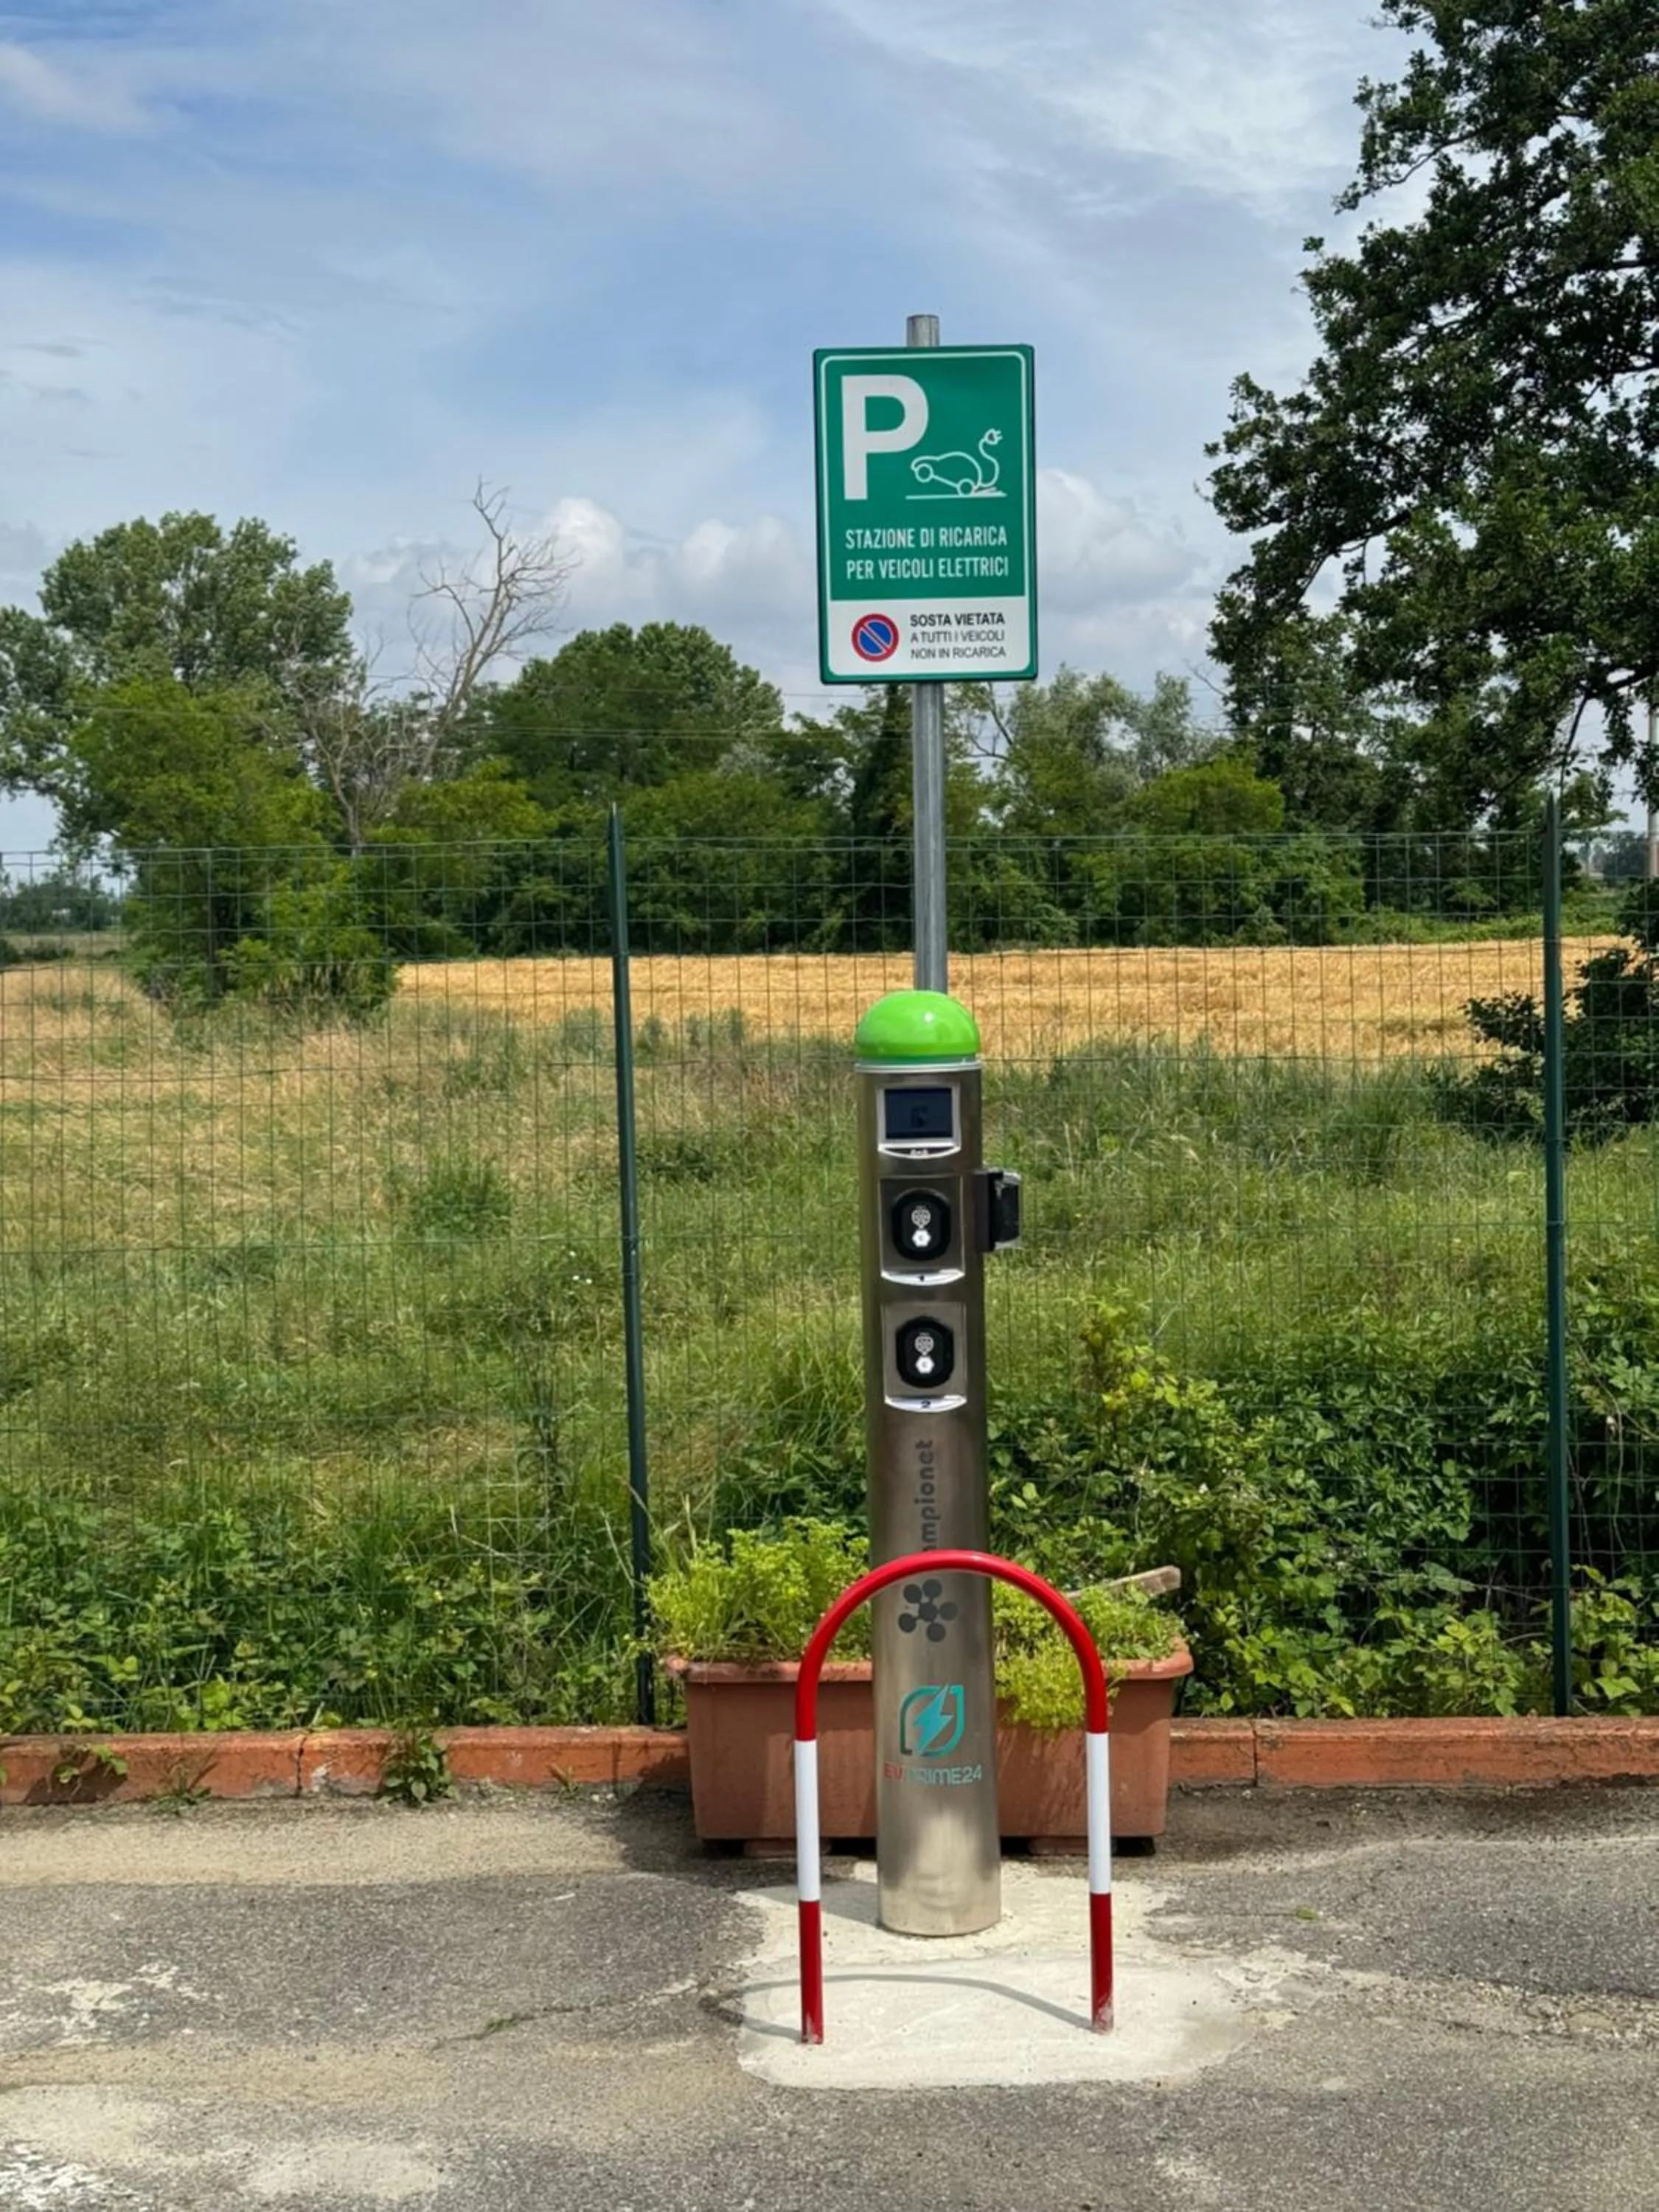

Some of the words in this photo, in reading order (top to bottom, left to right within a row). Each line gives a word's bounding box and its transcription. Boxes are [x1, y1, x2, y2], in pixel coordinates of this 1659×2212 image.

[841, 375, 929, 500] P
[845, 529, 916, 549] STAZIONE
[920, 527, 934, 548] DI
[939, 526, 1007, 546] RICARICA
[846, 559, 874, 580] PER
[878, 557, 933, 579] VEICOLI
[938, 555, 1009, 577] ELETTRICI
[910, 613, 951, 627] SOSTA
[954, 612, 1005, 625] VIETATA
[911, 633, 918, 642] A
[920, 630, 952, 643] TUTTI
[960, 630, 1004, 641] VEICOLI
[911, 648, 936, 659] NON
[939, 647, 950, 658] IN
[953, 646, 1006, 658] RICARICA
